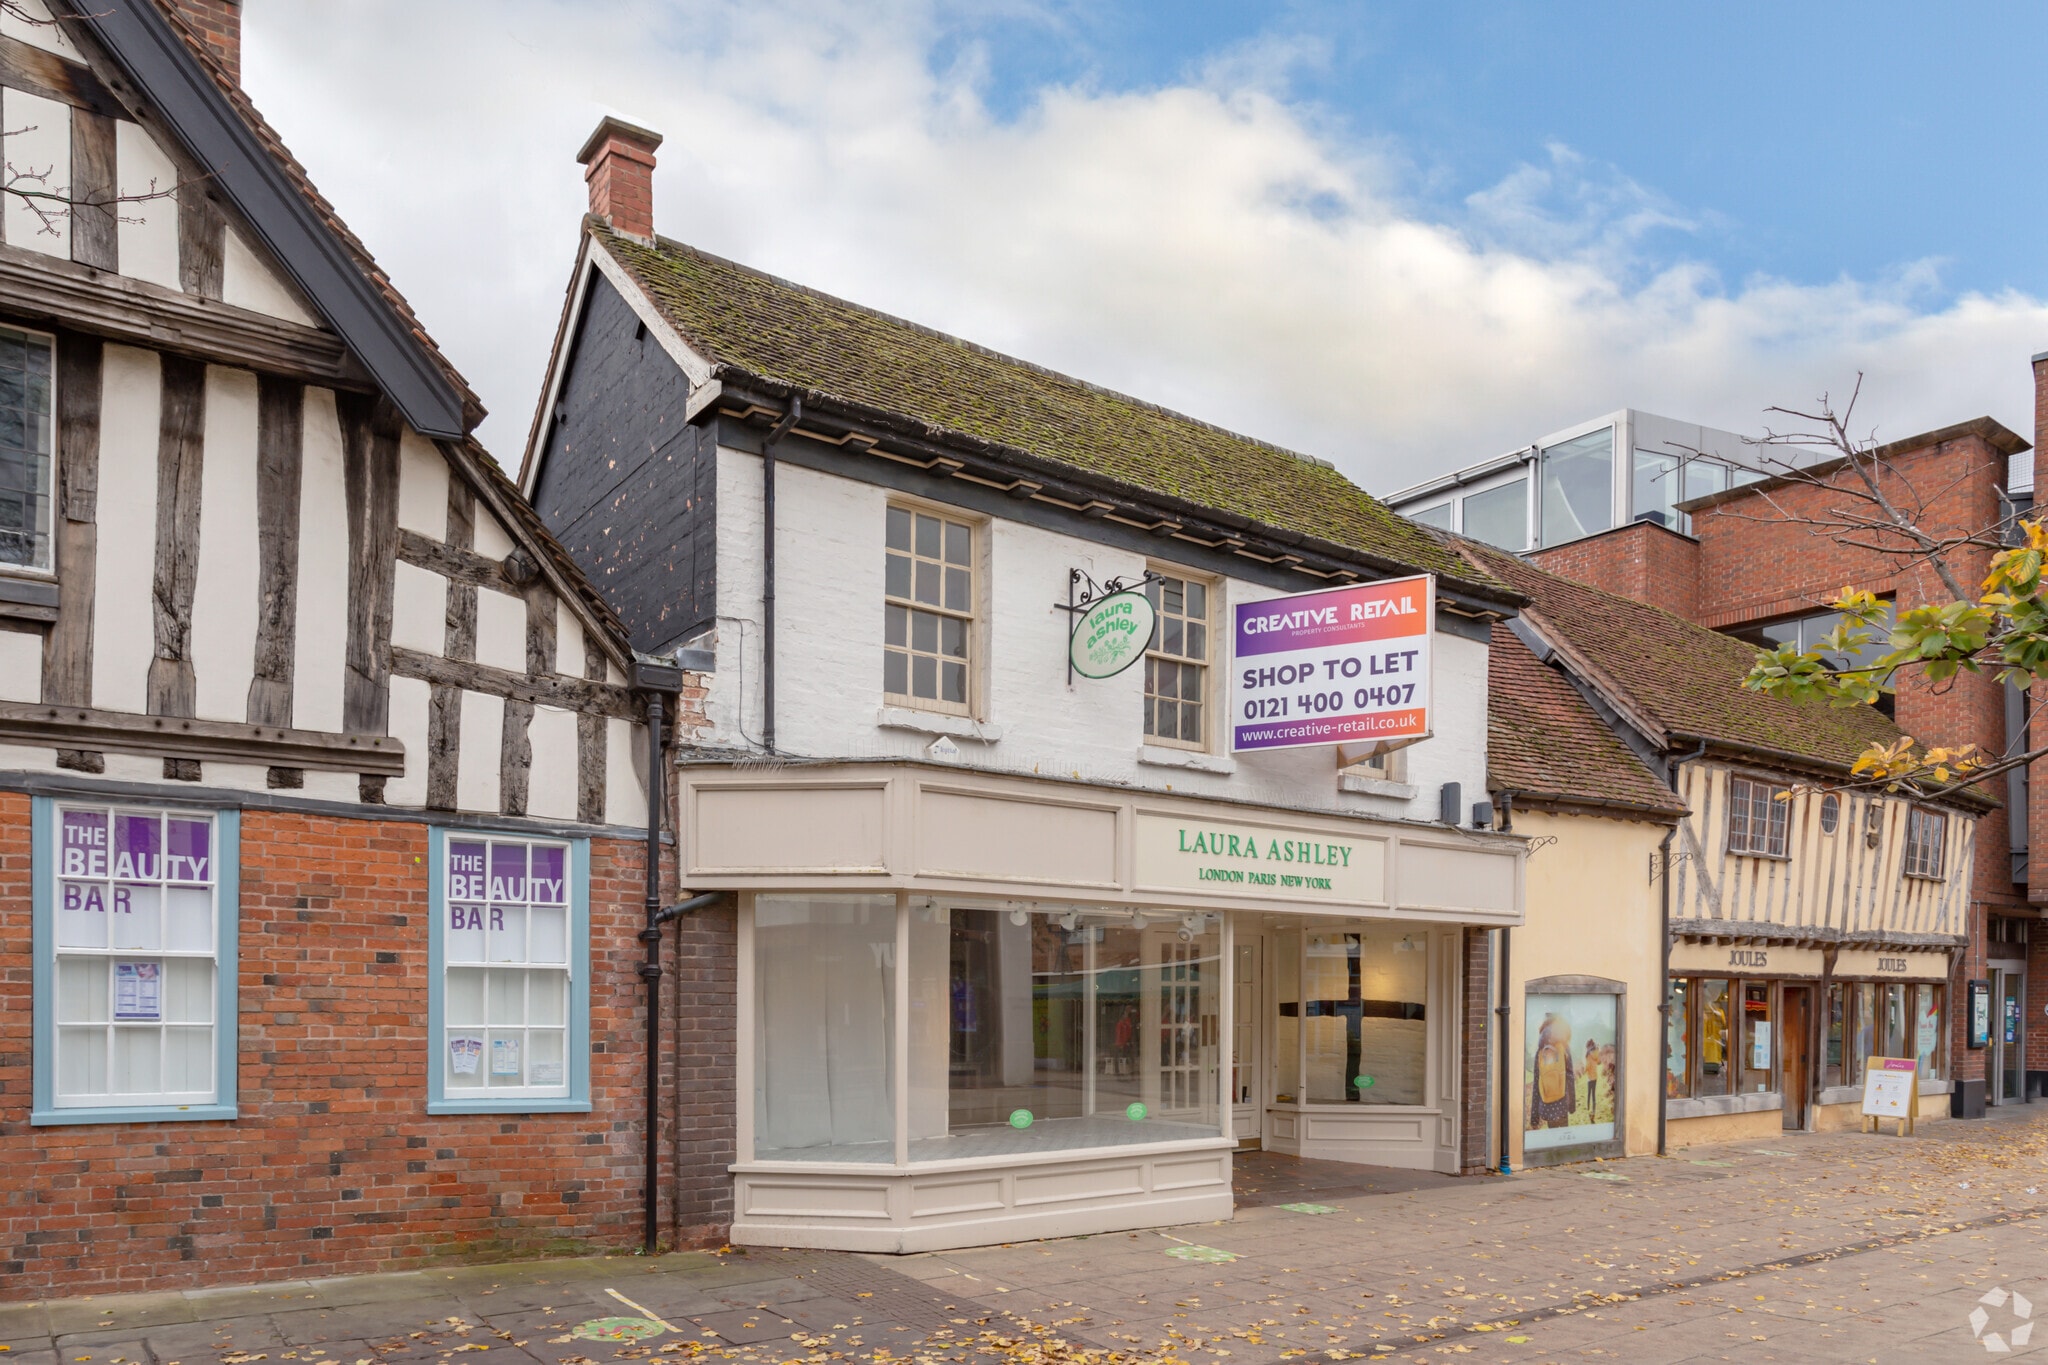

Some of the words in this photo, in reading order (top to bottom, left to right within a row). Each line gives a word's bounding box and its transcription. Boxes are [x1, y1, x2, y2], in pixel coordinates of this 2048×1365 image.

[1089, 602, 1133, 629] laura
[1243, 606, 1338, 635] CREATIVE
[1350, 596, 1418, 621] RETAIL
[1291, 627, 1322, 636] PROPERTY
[1323, 622, 1365, 633] CONSULTANTS
[1087, 617, 1138, 649] ashley
[1242, 663, 1314, 689] SHOP
[1323, 657, 1361, 680] TO
[1370, 650, 1418, 675] LET
[1244, 697, 1287, 719] 0121
[1298, 691, 1343, 713] 400
[1354, 684, 1415, 709] 0407
[1242, 714, 1416, 742] www.creative-retail.co.uk
[64, 825, 106, 846] THE
[1178, 829, 1258, 859] LAURA
[1266, 838, 1353, 867] ASHLEY
[64, 848, 208, 882] BEAUTY
[451, 854, 482, 872] THE
[450, 874, 563, 903] BEAUTY
[1199, 867, 1244, 883] LONDON
[1248, 871, 1276, 886] PARIS
[1280, 875, 1303, 887] NEW
[1305, 877, 1332, 890] YORK
[64, 884, 131, 914] BAR
[451, 906, 504, 931] BAR
[1729, 950, 1767, 967] JOULES
[1877, 957, 1907, 972] JOULES
